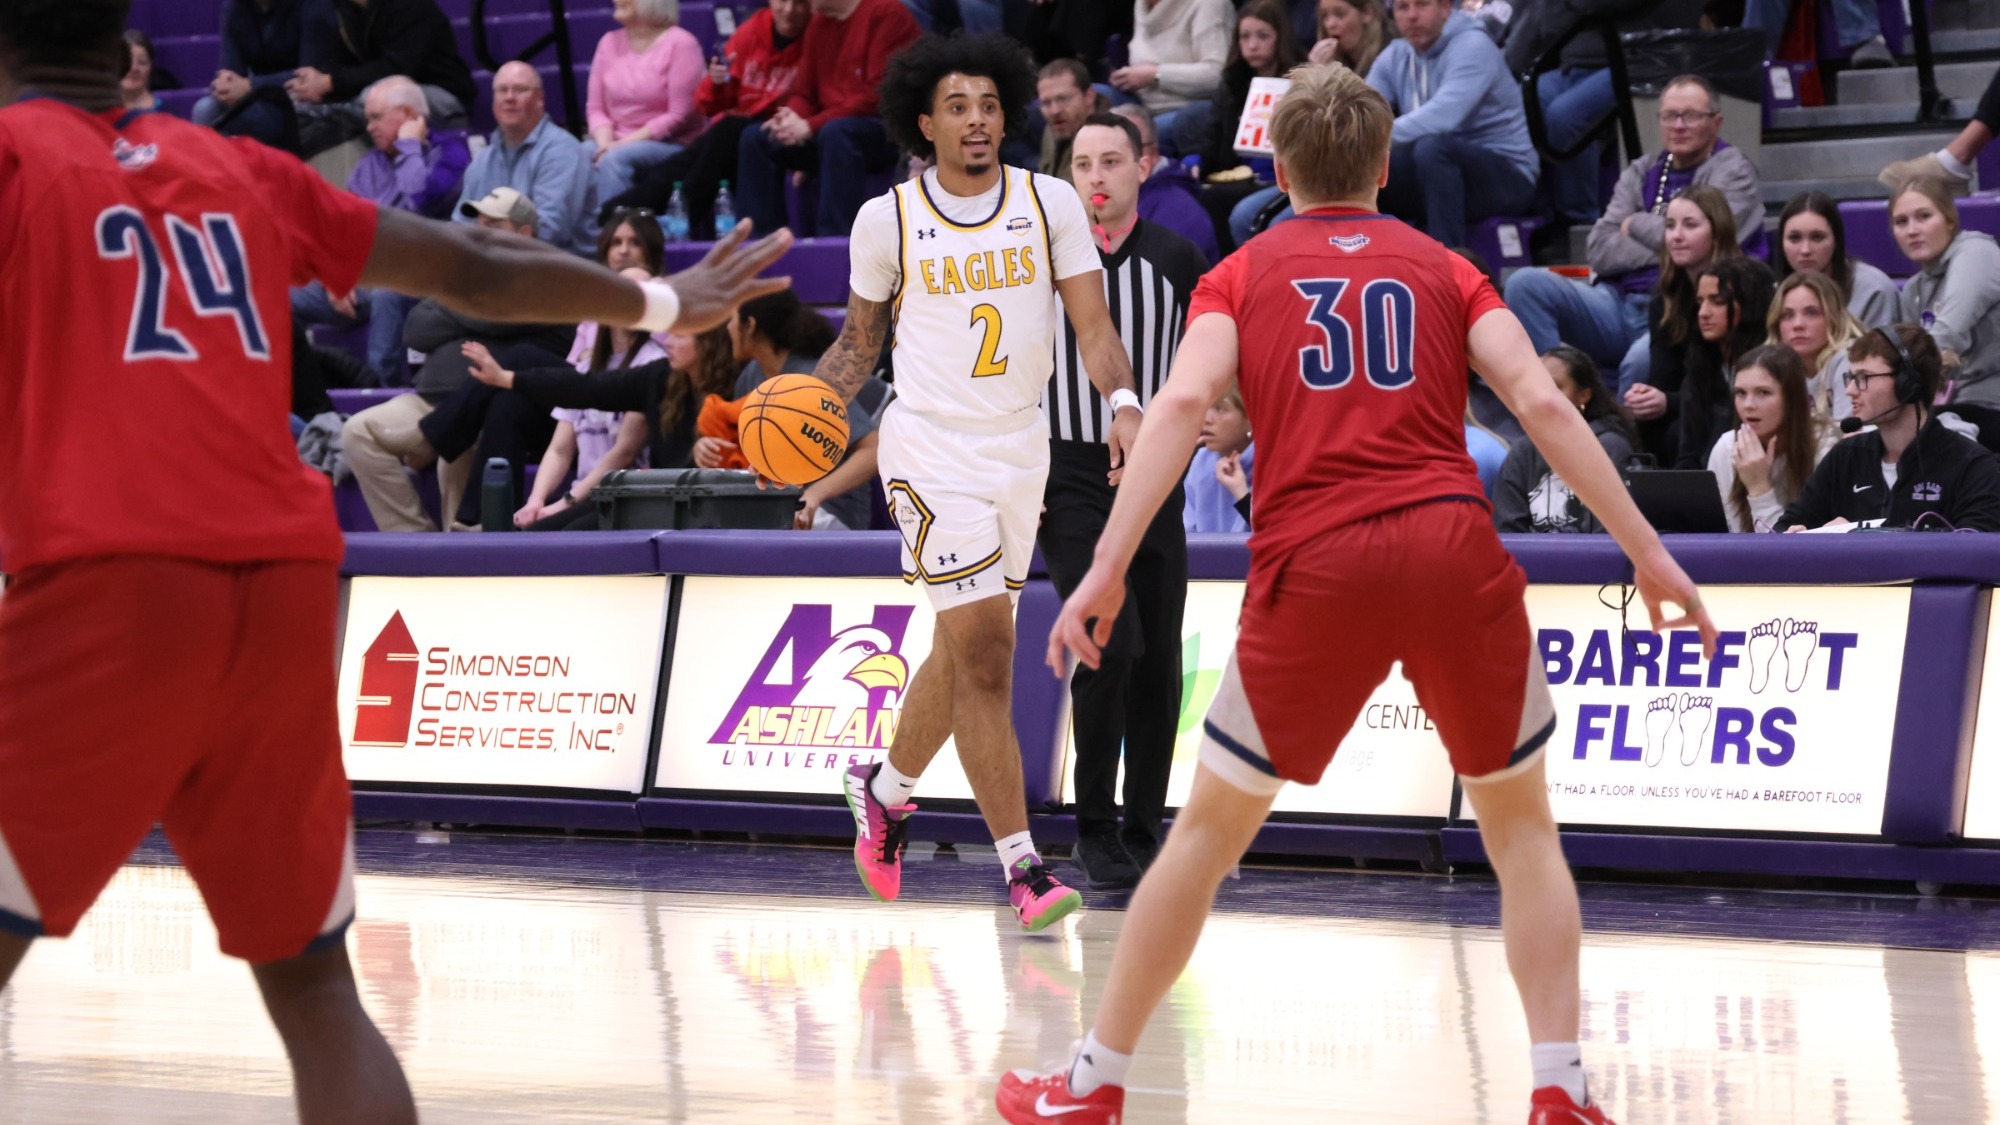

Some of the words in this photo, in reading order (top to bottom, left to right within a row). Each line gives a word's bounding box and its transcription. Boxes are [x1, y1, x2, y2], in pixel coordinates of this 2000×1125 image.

[95, 204, 270, 362] 24
[920, 246, 1035, 294] EAGLES
[970, 303, 1008, 378] 2
[1290, 277, 1416, 390] 30
[820, 397, 848, 423] CAA
[425, 647, 570, 677] SIMONSON
[421, 682, 636, 715] CONSTRUCTION
[728, 705, 902, 748] ASHLAN
[722, 750, 876, 769] UNIVERSI
[1564, 783, 1587, 795] HAD
[1590, 786, 1597, 795] A
[1641, 787, 1680, 798] UNLESS
[1685, 785, 1722, 799] YOU'VE
[1726, 788, 1749, 800] HAD
[1752, 790, 1760, 800] A
[1763, 789, 1822, 802] BAREFOOT
